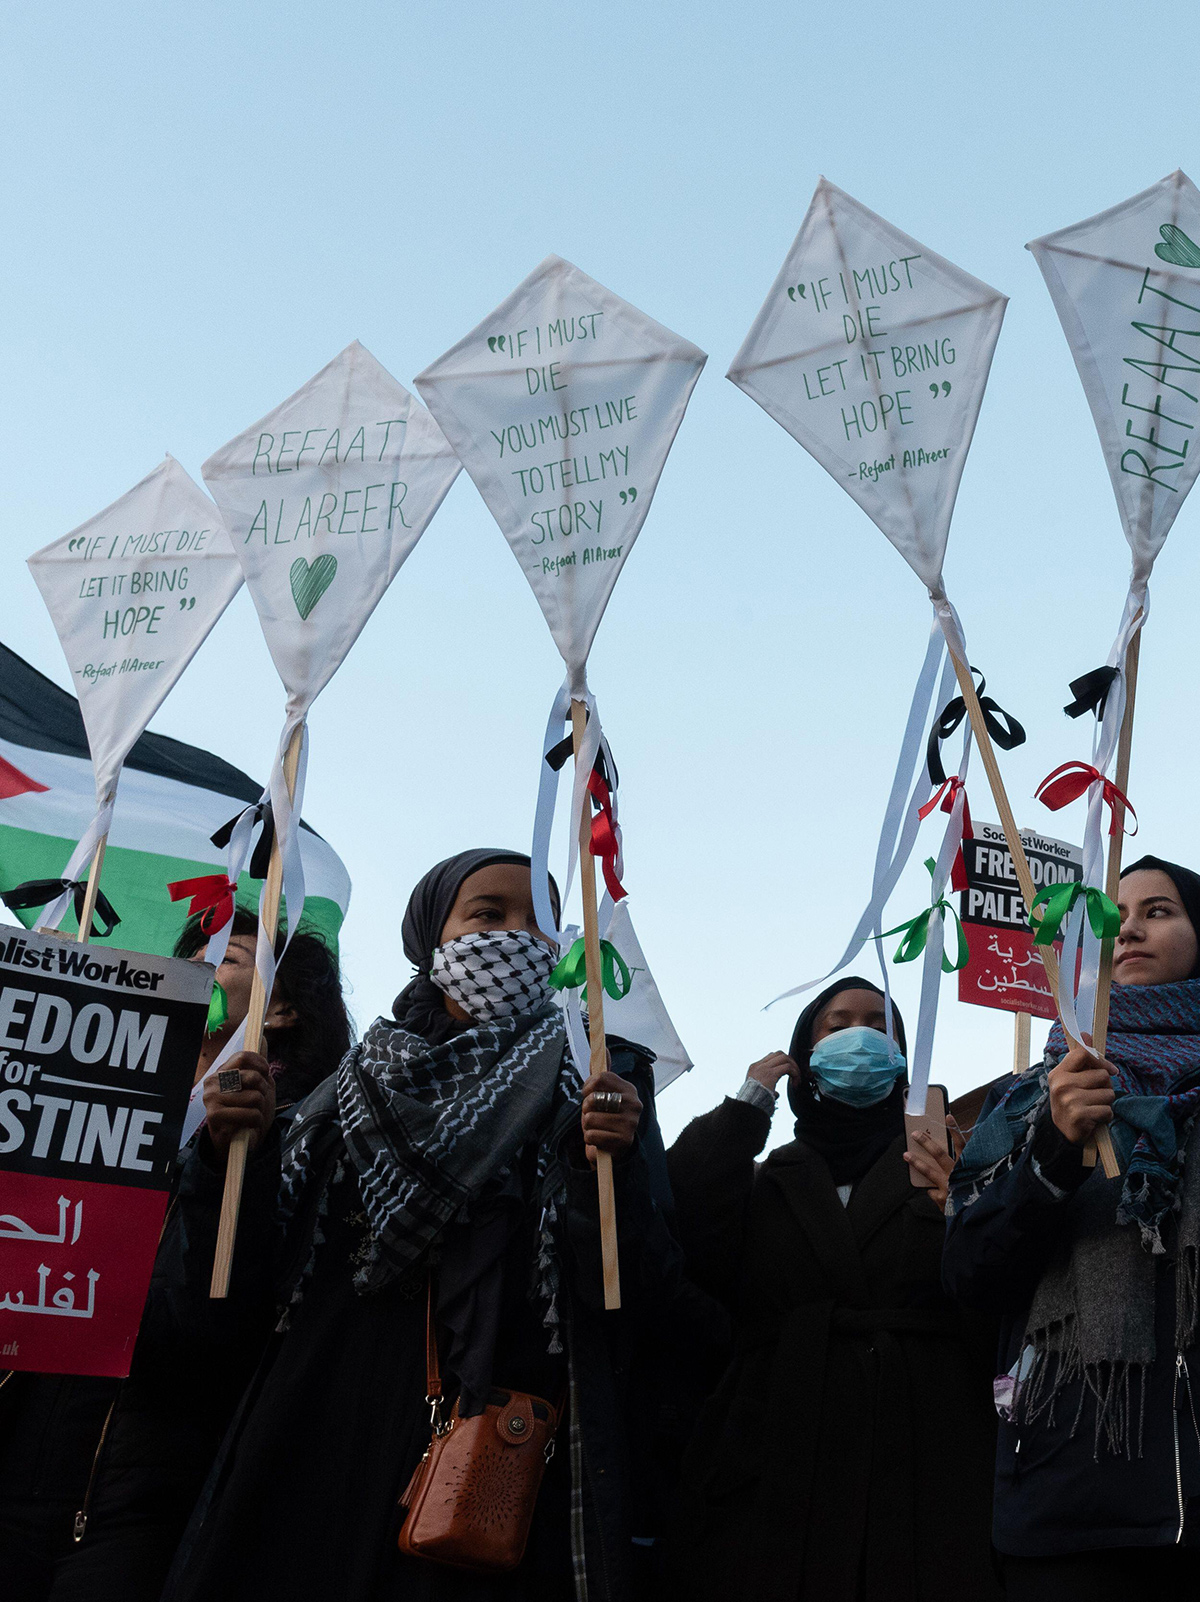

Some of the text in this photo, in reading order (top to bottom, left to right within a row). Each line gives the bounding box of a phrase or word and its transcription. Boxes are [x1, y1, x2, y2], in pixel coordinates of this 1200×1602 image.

[839, 272, 849, 304] I
[852, 255, 922, 301] MUST
[535, 326, 541, 355] I
[548, 312, 604, 348] MUST
[843, 306, 888, 344] DIE
[526, 362, 568, 395] DIE
[803, 338, 956, 400] LET IT BRING
[595, 396, 638, 430] LIVE
[252, 420, 407, 475] REFAAT
[108, 535, 119, 559] I
[121, 530, 179, 557] MUST
[176, 529, 210, 551] DIE
[79, 567, 189, 598] LET IT BRING
[975, 846, 1075, 887] FREDOM
